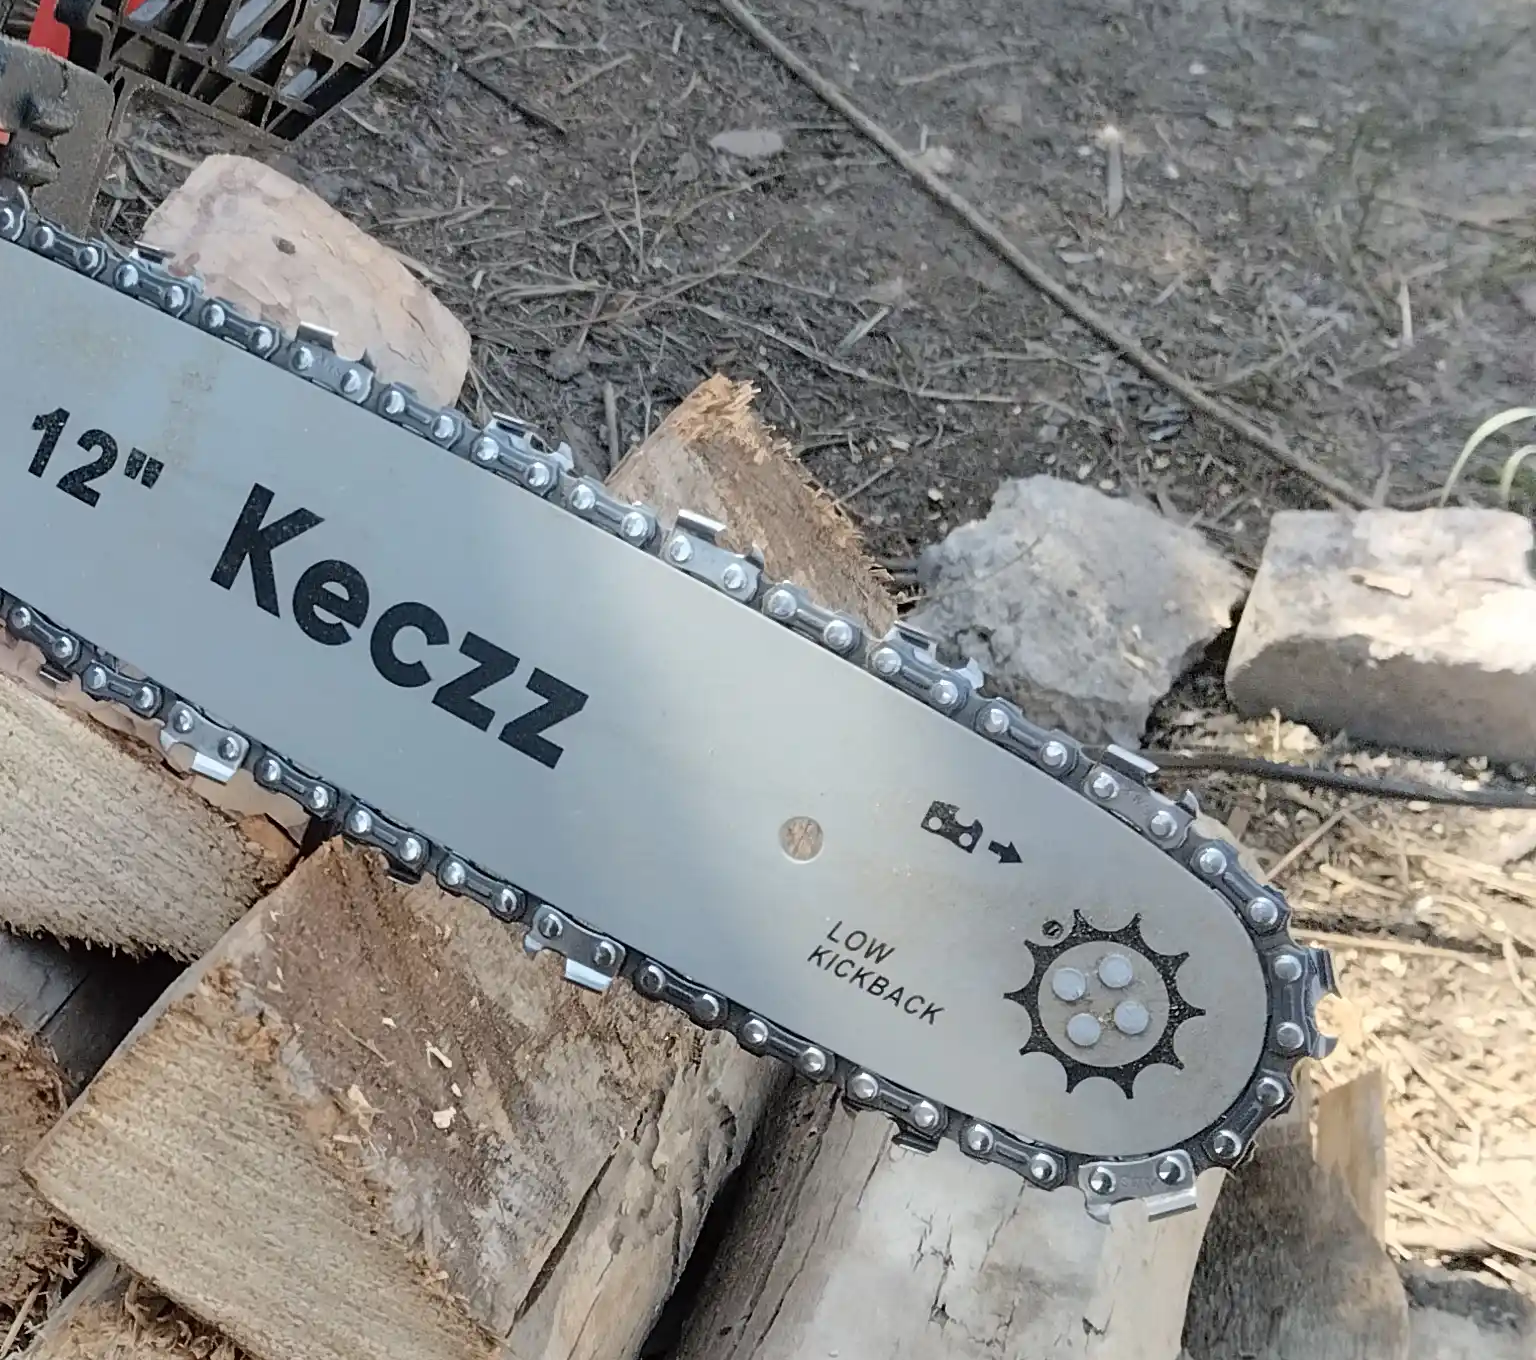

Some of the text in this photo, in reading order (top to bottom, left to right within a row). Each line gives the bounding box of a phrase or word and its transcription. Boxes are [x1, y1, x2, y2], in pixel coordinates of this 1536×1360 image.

[28, 407, 589, 769] 12" Keczz
[827, 921, 895, 963] LOW
[807, 945, 945, 1025] KICKBACK
